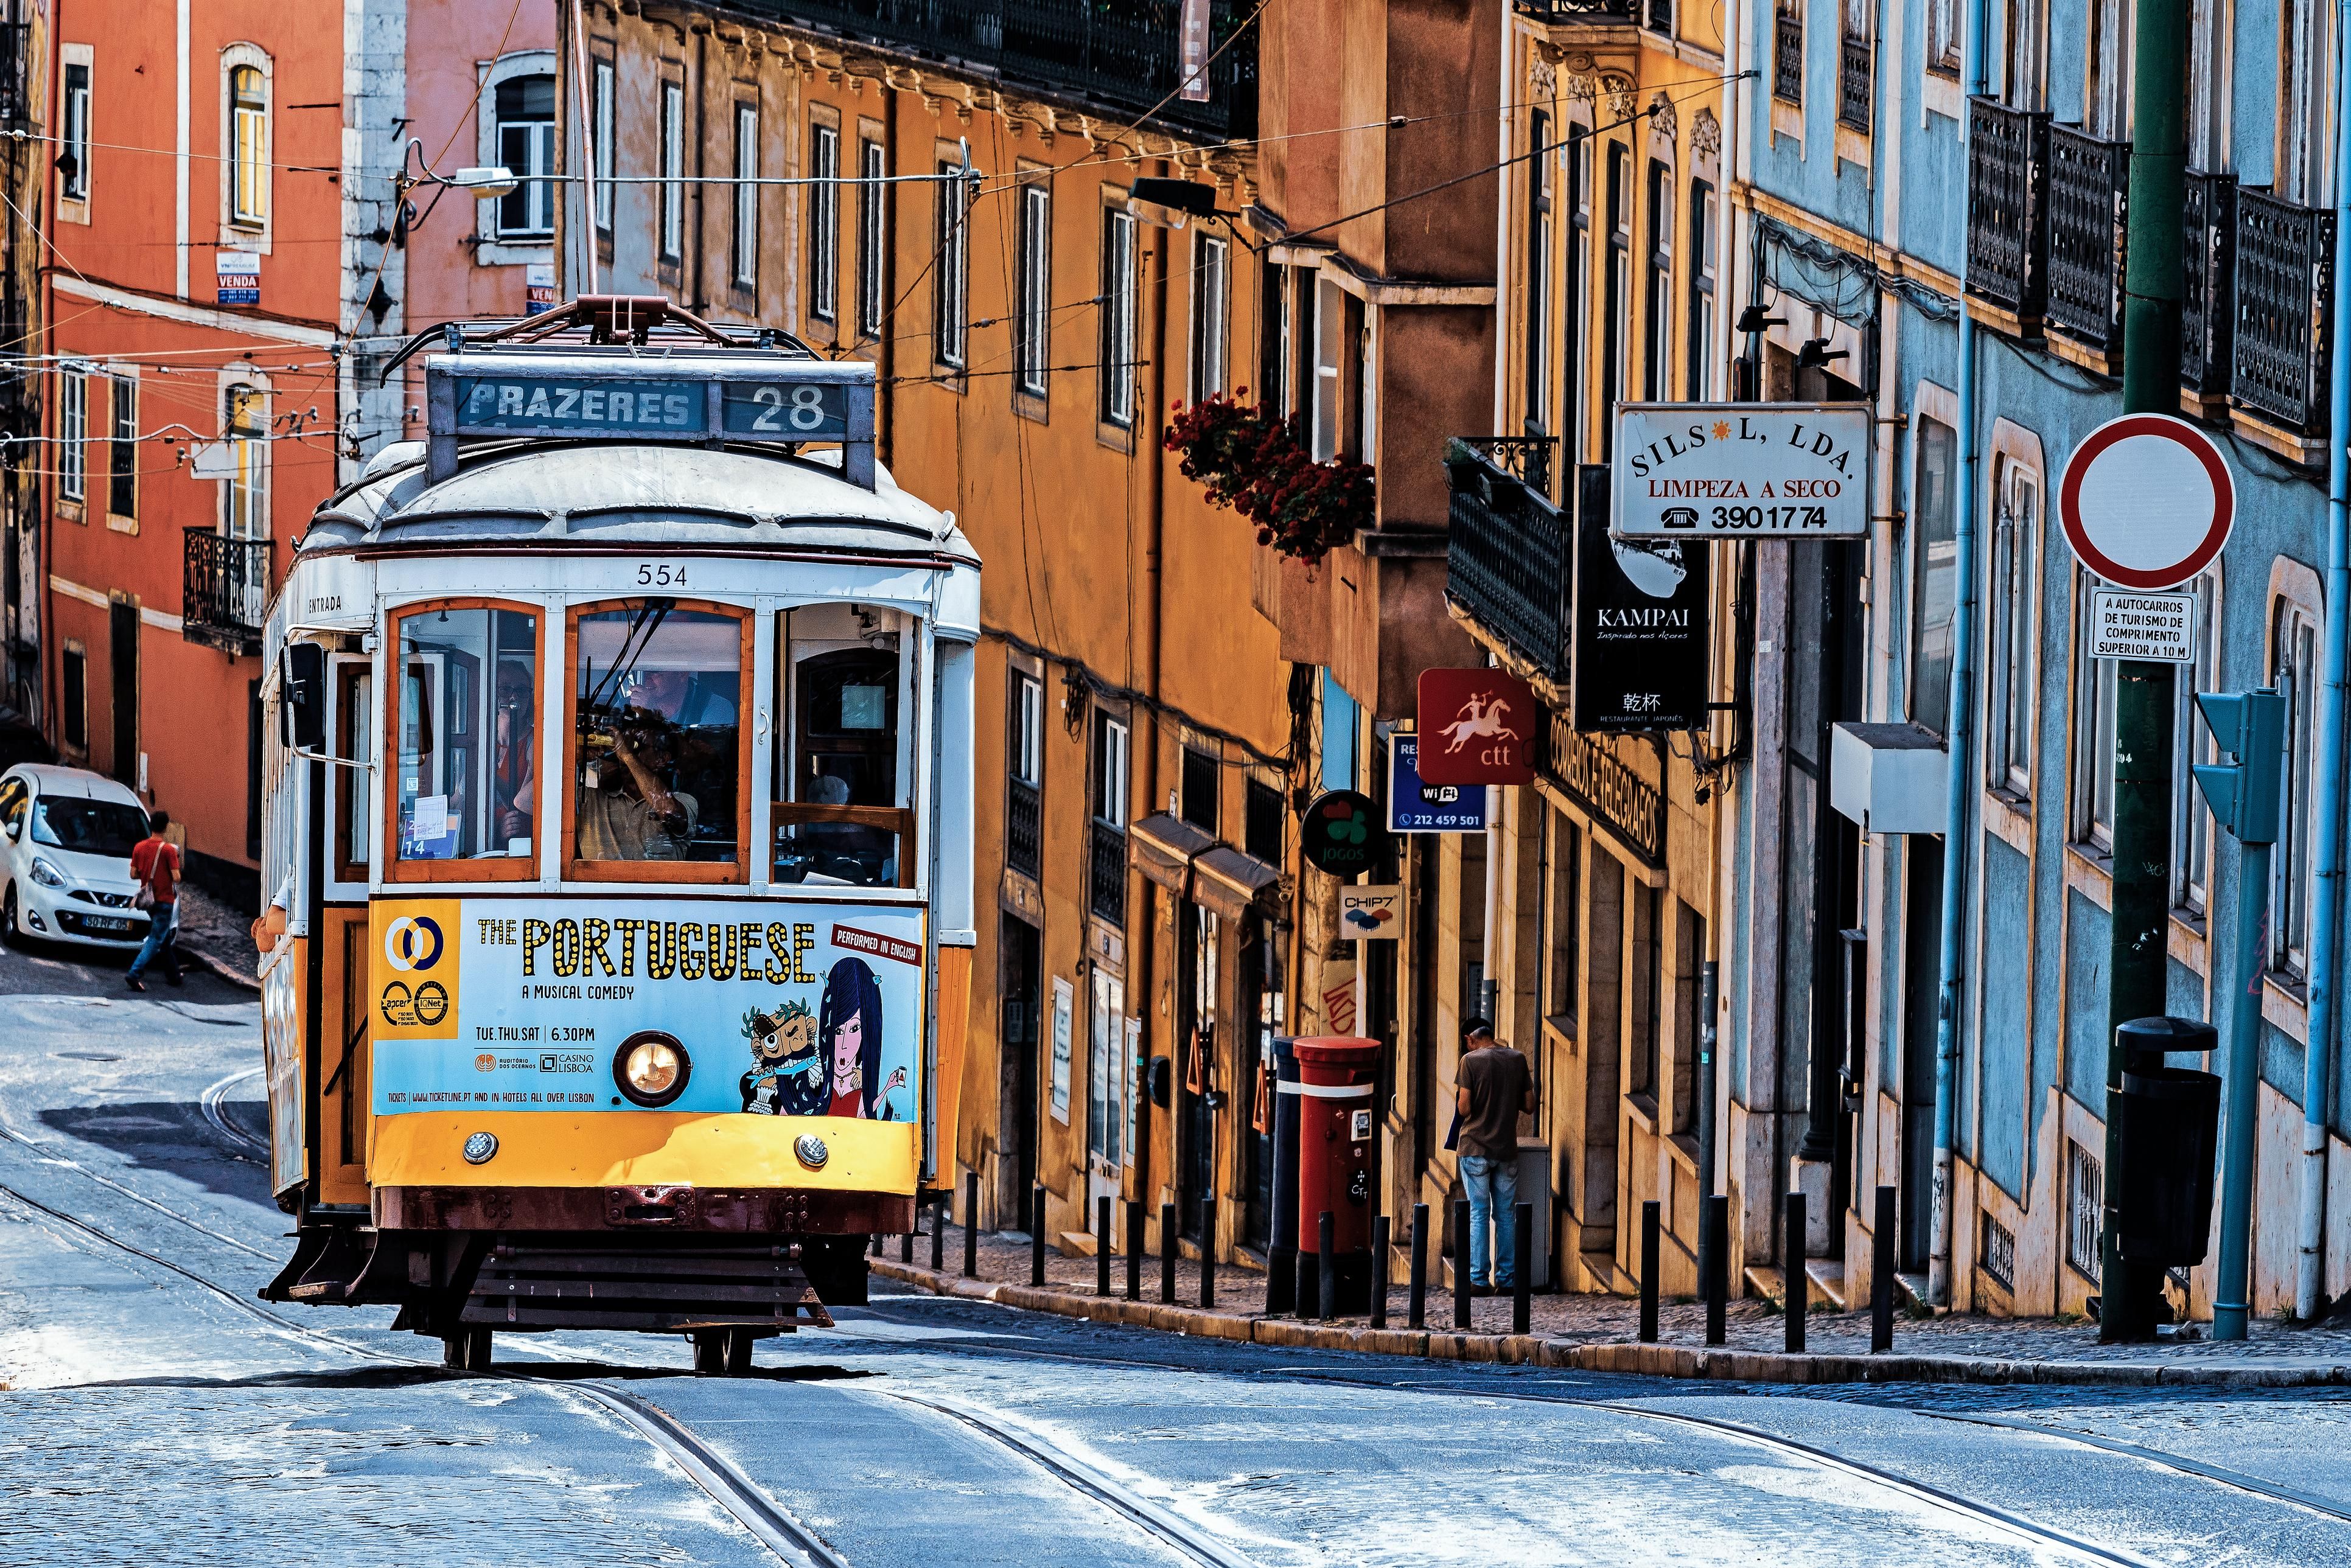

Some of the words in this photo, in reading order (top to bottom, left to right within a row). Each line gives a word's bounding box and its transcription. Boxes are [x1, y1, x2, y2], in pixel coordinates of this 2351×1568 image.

[219, 275, 257, 287] VENDA
[469, 384, 689, 425] PRAZERES
[752, 385, 824, 430] 28
[1787, 423, 1853, 479] LDA.
[1648, 479, 1750, 498] LIMPEZA
[1761, 479, 1776, 498] A
[1783, 479, 1842, 498] SECO
[637, 564, 687, 587] 554
[309, 595, 341, 614] ENTRADA
[2106, 598, 2113, 608] A
[2115, 598, 2183, 613] AUTOCARROS
[1597, 608, 1689, 626] KAMPAI
[2105, 612, 2118, 624] DE
[2121, 613, 2167, 627] TURISMO
[2170, 616, 2184, 628] DE
[1597, 632, 1637, 641] Inspirado
[1658, 630, 1688, 640] Açores
[2106, 627, 2180, 643] COMPRIMENTO
[2098, 641, 2150, 655] SUPERIOR
[2152, 645, 2159, 656] A
[2163, 646, 2175, 657] 10
[2178, 647, 2186, 658] M
[1623, 692, 1661, 712] 乾杯
[1481, 745, 1511, 765] ctt
[1414, 815, 1433, 825] 212
[1436, 815, 1457, 826] 459
[1460, 816, 1479, 826] 501
[405, 840, 425, 855] 14
[1322, 846, 1364, 863] JOGOS
[1344, 897, 1394, 908] CHIP7
[477, 919, 517, 944] THE
[523, 918, 816, 986] PORTUGUESE
[837, 930, 878, 950] PERFORMED
[880, 940, 889, 954] IN
[890, 942, 917, 961] ENGLISH
[522, 985, 529, 999] A
[534, 984, 582, 999] MUSICAL
[587, 985, 635, 1000] COMEDY
[420, 999, 441, 1008] IQNet
[476, 1026, 540, 1041] TUE.THU.SAT
[551, 1027, 595, 1042] 6.30PM
[559, 1054, 594, 1063] CASINO
[558, 1064, 594, 1073] LISBOA
[388, 1092, 406, 1103] TICKETS
[413, 1092, 471, 1103] WWW.TICKETLINE.PT
[474, 1092, 488, 1102] AND
[491, 1092, 499, 1103] IN
[503, 1092, 527, 1103] HOTELS
[531, 1093, 543, 1103] ALL
[547, 1093, 565, 1103] OVER
[568, 1093, 595, 1103] LISBON
